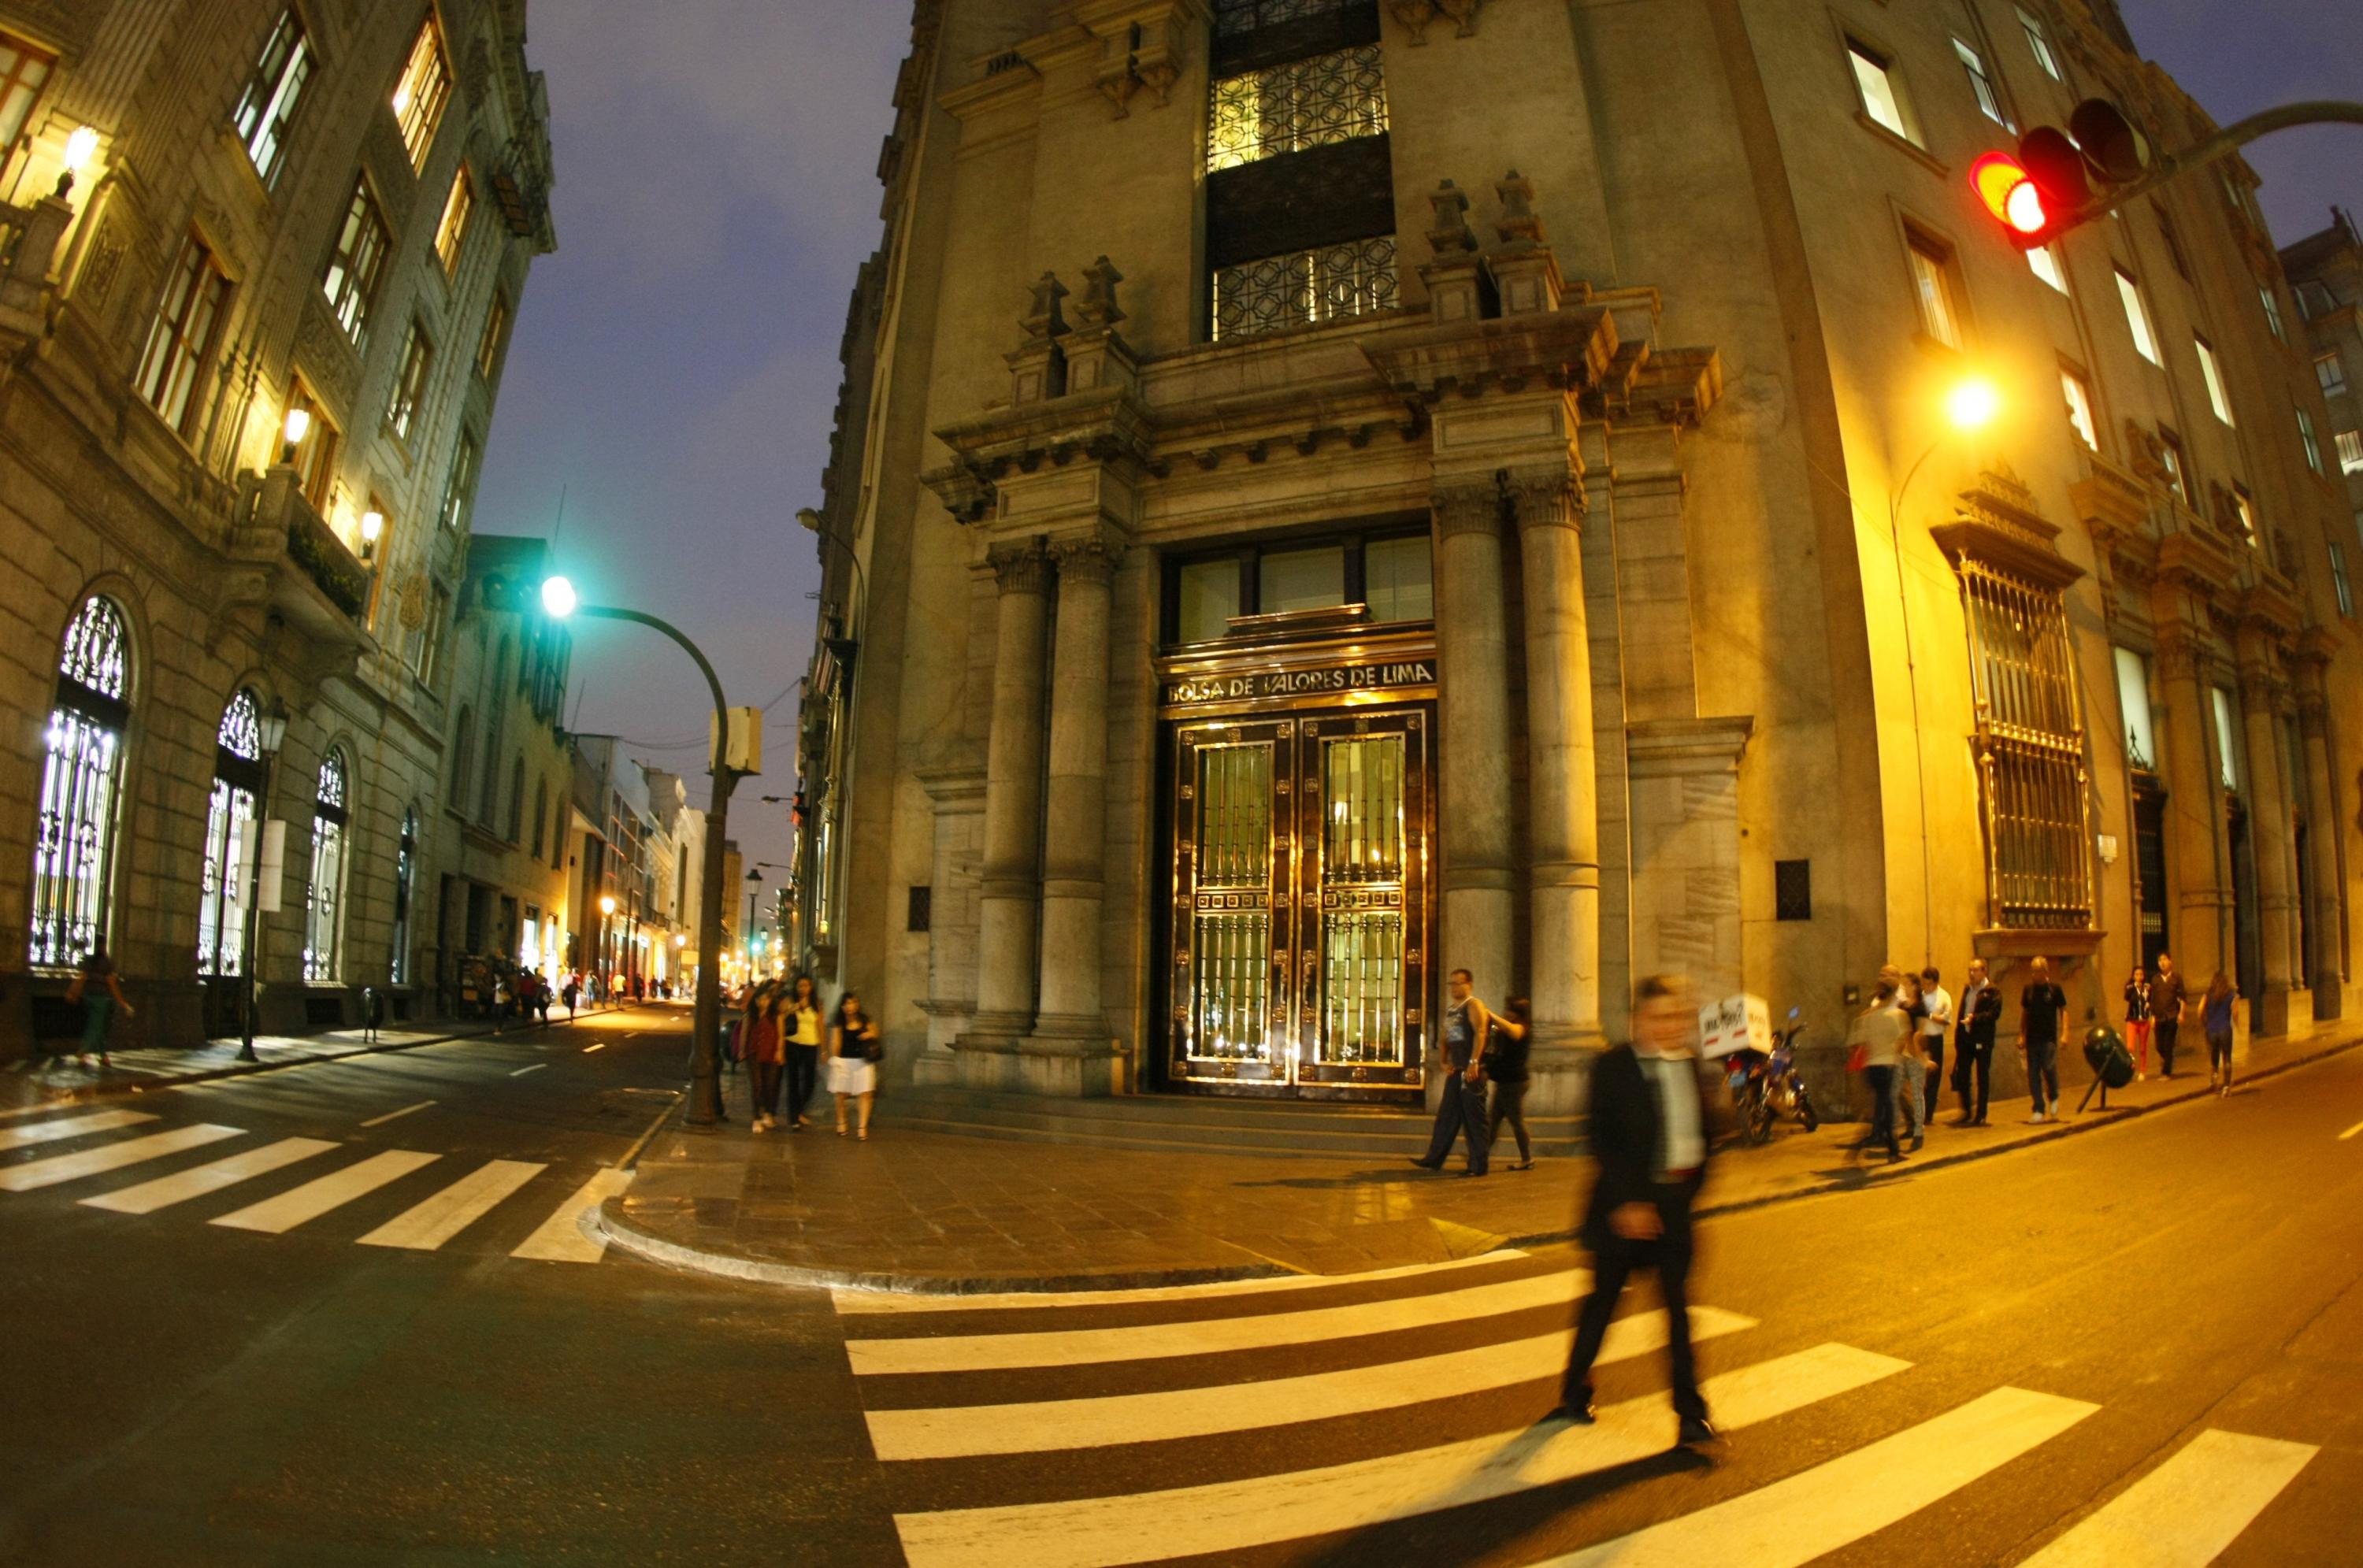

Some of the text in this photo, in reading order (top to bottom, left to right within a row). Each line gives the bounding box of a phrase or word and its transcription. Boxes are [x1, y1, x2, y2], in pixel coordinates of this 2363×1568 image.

[1169, 664, 1433, 702] BOLSA DE VALORES DE LIMA
